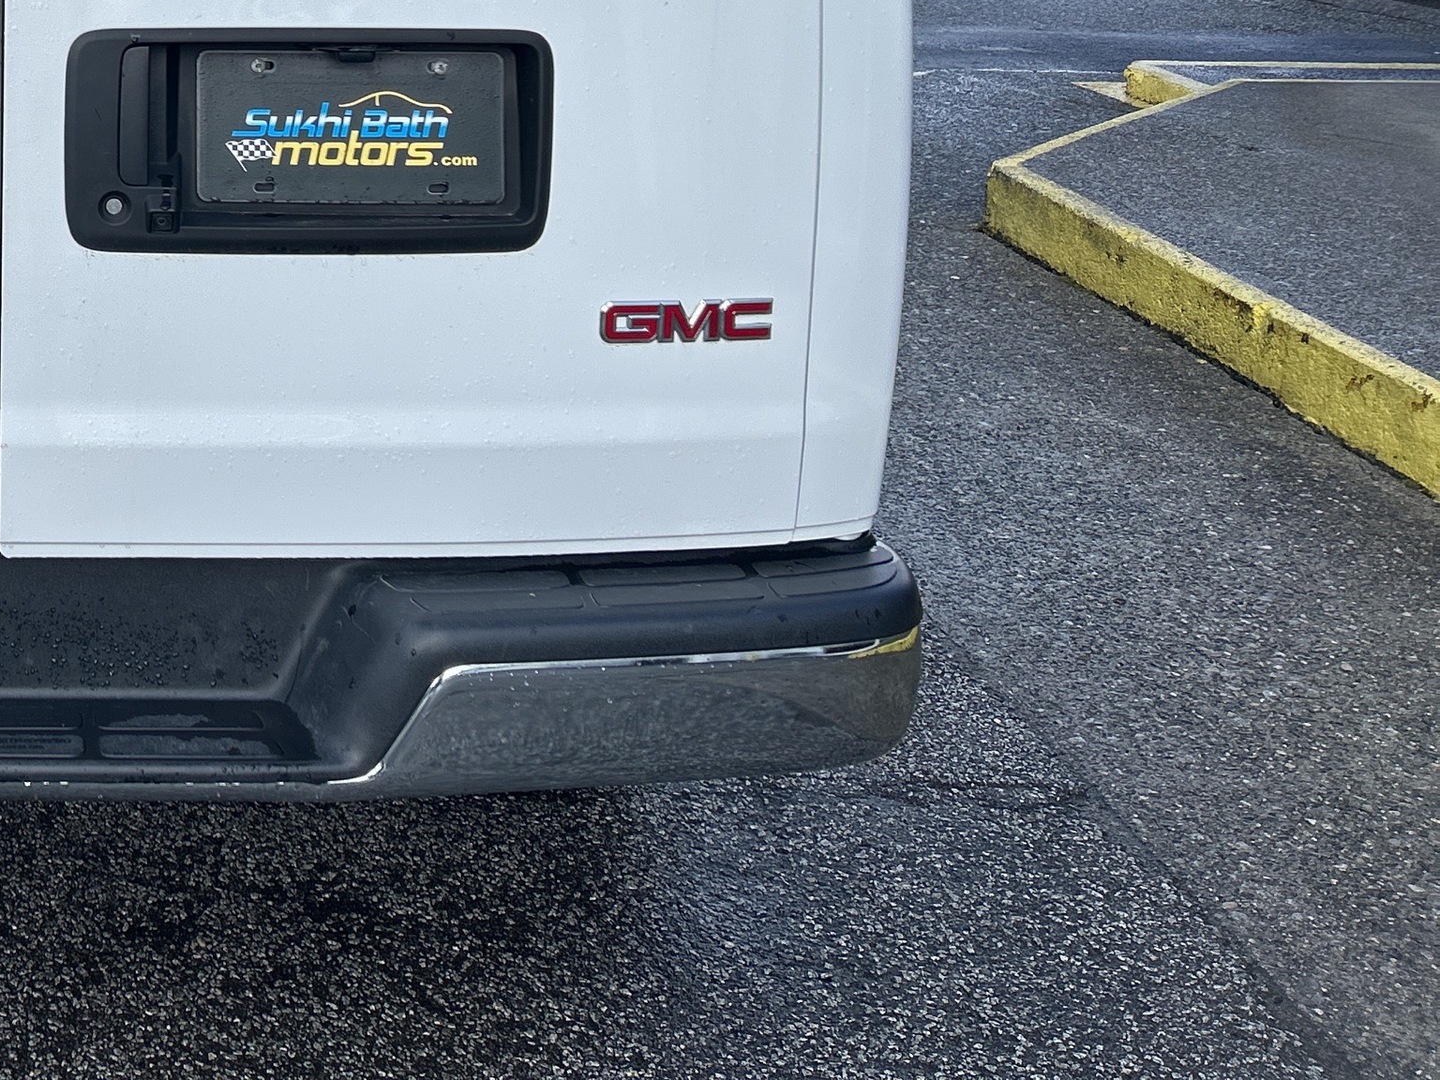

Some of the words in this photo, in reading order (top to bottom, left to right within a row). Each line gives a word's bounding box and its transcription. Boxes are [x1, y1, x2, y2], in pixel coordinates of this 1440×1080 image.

[231, 101, 354, 138] Sukhi
[360, 109, 449, 138] Bath
[599, 297, 774, 344] GMC
